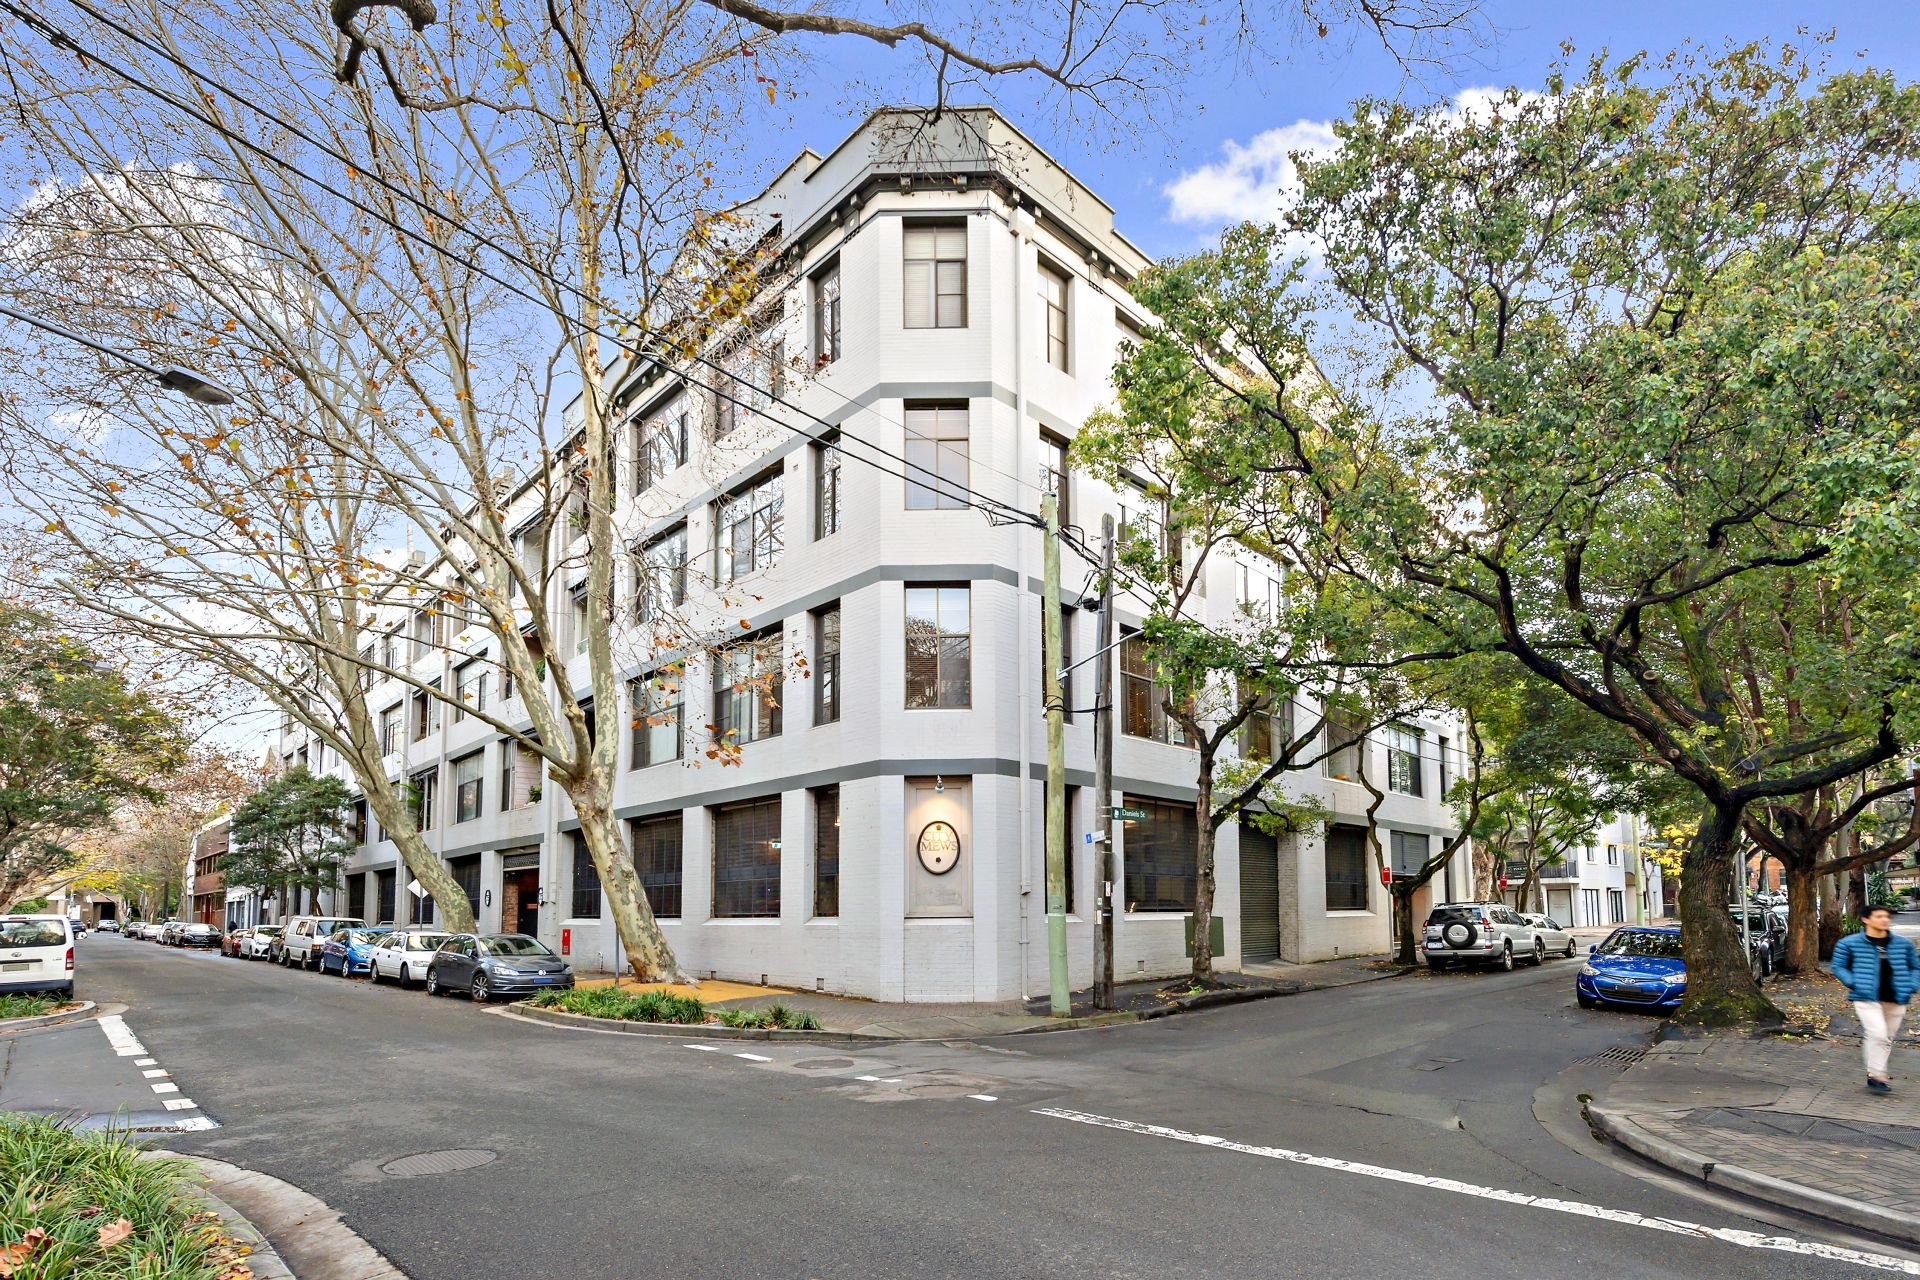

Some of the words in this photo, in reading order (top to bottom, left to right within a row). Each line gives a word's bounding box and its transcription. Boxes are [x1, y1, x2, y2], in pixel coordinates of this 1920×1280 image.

[1121, 809, 1139, 818] Daniels
[1140, 810, 1146, 818] St
[922, 831, 954, 841] CITY
[920, 841, 958, 851] MEWS
